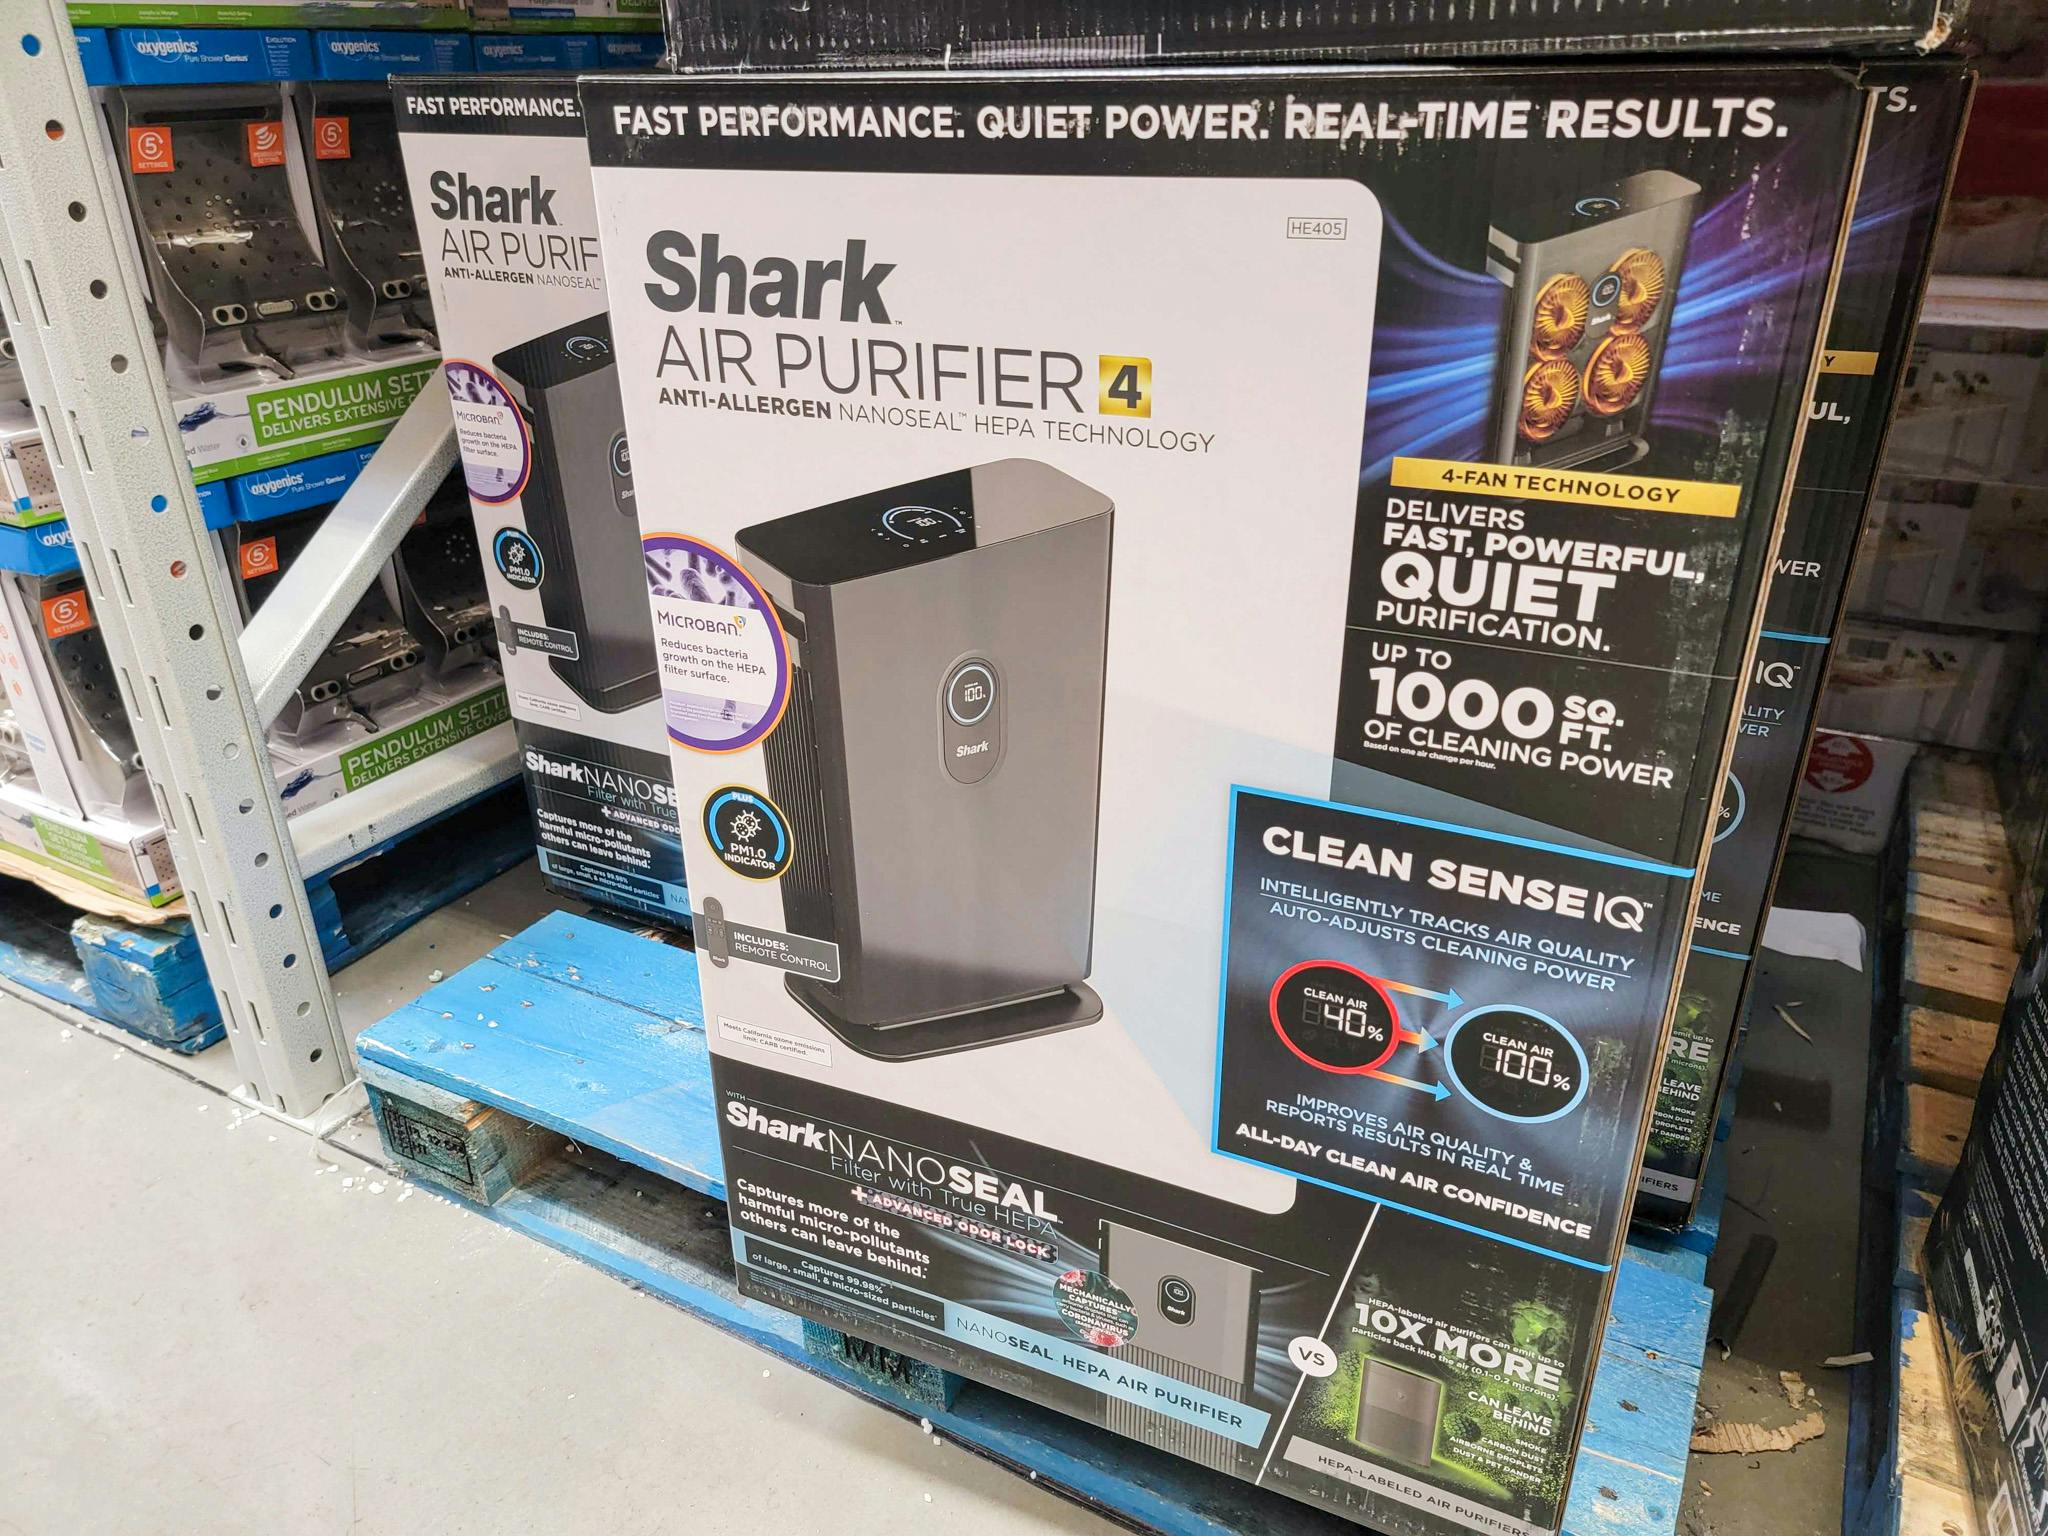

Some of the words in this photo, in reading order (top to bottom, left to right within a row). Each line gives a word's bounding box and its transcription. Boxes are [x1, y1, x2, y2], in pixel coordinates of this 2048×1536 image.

[331, 40, 379, 53] oxygenics
[406, 97, 446, 115] FAST
[450, 97, 581, 117] PERFORMANCE.
[613, 105, 688, 137] FAST
[700, 105, 965, 139] PERFORMANCE.
[977, 104, 1093, 140] QUIET
[1106, 104, 1267, 139] POWER.
[1285, 99, 1528, 140] REAL-TIME
[1545, 97, 1788, 140] RESULTS.
[144, 137, 157, 153] 5
[1290, 219, 1344, 238] HE405
[442, 228, 493, 264] AIR
[501, 232, 598, 272] PURIF
[445, 267, 534, 284] ANTI-ALLERGEN
[656, 324, 757, 386] AIR
[776, 332, 1085, 412] PURIFIER
[1107, 365, 1142, 409] 4
[256, 380, 382, 422] PENDULUM
[262, 413, 331, 438] DELIVERS
[334, 398, 407, 423] EXTENSIVE
[659, 387, 831, 420] ANTI-ALLERGEN
[975, 415, 1035, 438] HEPA
[1043, 420, 1215, 454] TECHNOLOGY
[1442, 469, 1507, 488] 4-FAN
[1515, 474, 1680, 503] TECHNOLOGY
[1386, 498, 1526, 531] DELIVERS
[1383, 523, 1475, 558] FAST,
[1484, 533, 1704, 584] POWERFUL,
[1381, 551, 1616, 622] QUIET
[59, 603, 72, 619] 5
[1376, 600, 1610, 652] PURIFICATION.
[518, 629, 549, 640] INCLUDES:
[519, 637, 543, 647] REMOTE
[544, 641, 573, 653] CONTROL
[661, 638, 703, 653] Reduces
[706, 644, 748, 660] bacteria
[663, 652, 699, 665] growth
[701, 658, 713, 666] on
[716, 659, 734, 670] the
[737, 663, 766, 675] HEPA
[1371, 642, 1408, 663] UP
[1415, 647, 1452, 670] TO
[664, 664, 688, 676] filter
[691, 668, 730, 684] surface.
[1369, 667, 1554, 739] 1000
[1562, 695, 1624, 727] SQ.
[346, 712, 455, 774] PENDULUM
[956, 740, 989, 757] Shark
[1559, 720, 1613, 751] FT.
[352, 752, 411, 788] DELIVERS
[412, 726, 474, 760] EXTENSIVE
[1364, 720, 1402, 740] OF
[1408, 726, 1552, 767] CLEANING
[1560, 751, 1674, 789] POWER
[1364, 741, 1388, 751] Based
[1401, 747, 1416, 756] one
[1428, 752, 1458, 764] change
[1459, 757, 1474, 766] per
[1475, 759, 1496, 770] hour.
[732, 792, 753, 803] PLUS
[724, 853, 776, 870] INDICATOR
[731, 843, 767, 859] PM1.0
[1262, 826, 1413, 881] CLEAN
[1427, 858, 1589, 919] SENSE
[734, 932, 789, 951] INCLUDES:
[736, 942, 777, 959] REMOTE
[780, 953, 831, 972] CONTROL
[1482, 1032, 1527, 1050] CLEAN
[1530, 1043, 1554, 1058] AIR
[1494, 1048, 1571, 1091] 100%
[726, 1089, 746, 1101] WITH
[1663, 1078, 1702, 1093] LEAVE
[1671, 1106, 1696, 1116] SMOKE
[1655, 1120, 1692, 1133] DROPLETS
[1236, 1123, 1322, 1159] ALL-DAY
[1326, 1149, 1397, 1180] CLEAN
[1400, 1170, 1439, 1193] AIR
[1443, 1184, 1593, 1239] CONFIDENCE
[831, 1156, 881, 1183] Filter
[889, 1176, 932, 1200] with
[940, 1189, 986, 1216] True
[994, 1208, 1058, 1240] HEPA
[872, 1193, 952, 1226] ADVANCED
[957, 1221, 1001, 1242] ODOR
[1006, 1235, 1049, 1258] LOCK
[752, 1253, 763, 1262] of
[764, 1257, 791, 1273] large,
[793, 1267, 821, 1283] small,
[823, 1277, 830, 1285] &
[832, 1278, 889, 1305] micro-sized
[801, 1261, 845, 1282] Captures
[1060, 1284, 1131, 1313] MECHANICALLY
[1062, 1309, 1128, 1336] CORONAVIRUS
[1368, 1297, 1434, 1326] HEPA-labeled
[1435, 1316, 1449, 1329] air
[1449, 1324, 1491, 1345] purifiers
[1493, 1338, 1511, 1350] can
[1512, 1344, 1536, 1359] emit
[1537, 1355, 1552, 1366] up
[1553, 1358, 1565, 1368] to
[1298, 1347, 1326, 1366] VS
[1354, 1302, 1428, 1345] 10X
[1434, 1330, 1563, 1392] MORE
[1062, 1355, 1112, 1382] HEPA
[1116, 1373, 1149, 1395] AIR
[1154, 1387, 1243, 1429] PURIFIER
[1468, 1391, 1500, 1411] CAN
[1504, 1402, 1553, 1428] LEAVE
[1493, 1409, 1551, 1437] BEHIND
[1449, 1435, 1496, 1459] AIRBORNE
[1498, 1452, 1544, 1473] DROPLETS
[1481, 1436, 1519, 1454] CARBON
[1520, 1448, 1545, 1464] DUST
[1515, 1438, 1548, 1454] SMOKE
[1452, 1447, 1476, 1462] DUST
[1485, 1458, 1502, 1471] PET
[1503, 1464, 1542, 1484] DANDER
[1318, 1455, 1423, 1500] HEPA-LABELED
[1426, 1495, 1451, 1511] AIR
[1454, 1506, 1530, 1536] PURIFIERS
